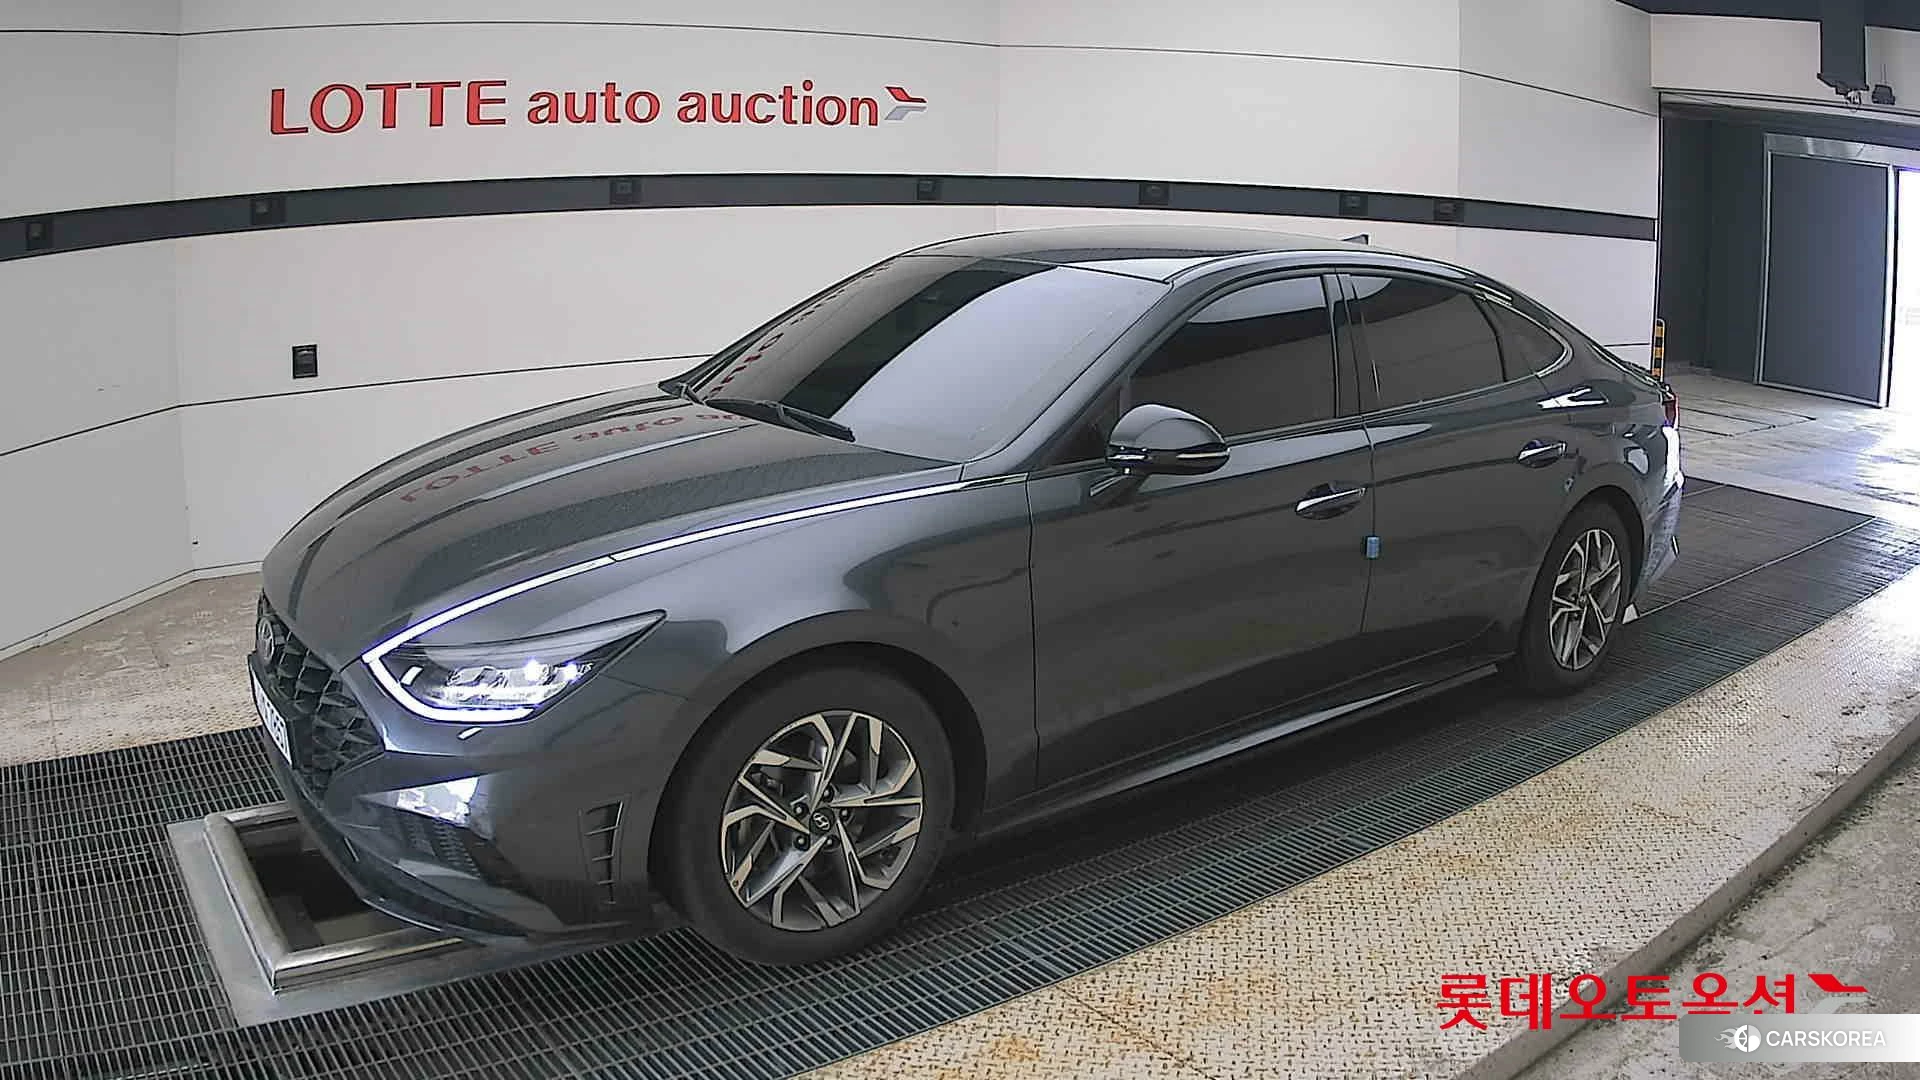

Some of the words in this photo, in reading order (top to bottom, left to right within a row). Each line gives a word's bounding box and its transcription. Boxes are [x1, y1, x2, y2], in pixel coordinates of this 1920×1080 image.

[269, 80, 506, 134] LOTTE
[527, 81, 661, 124] auto
[677, 80, 879, 127] auction
